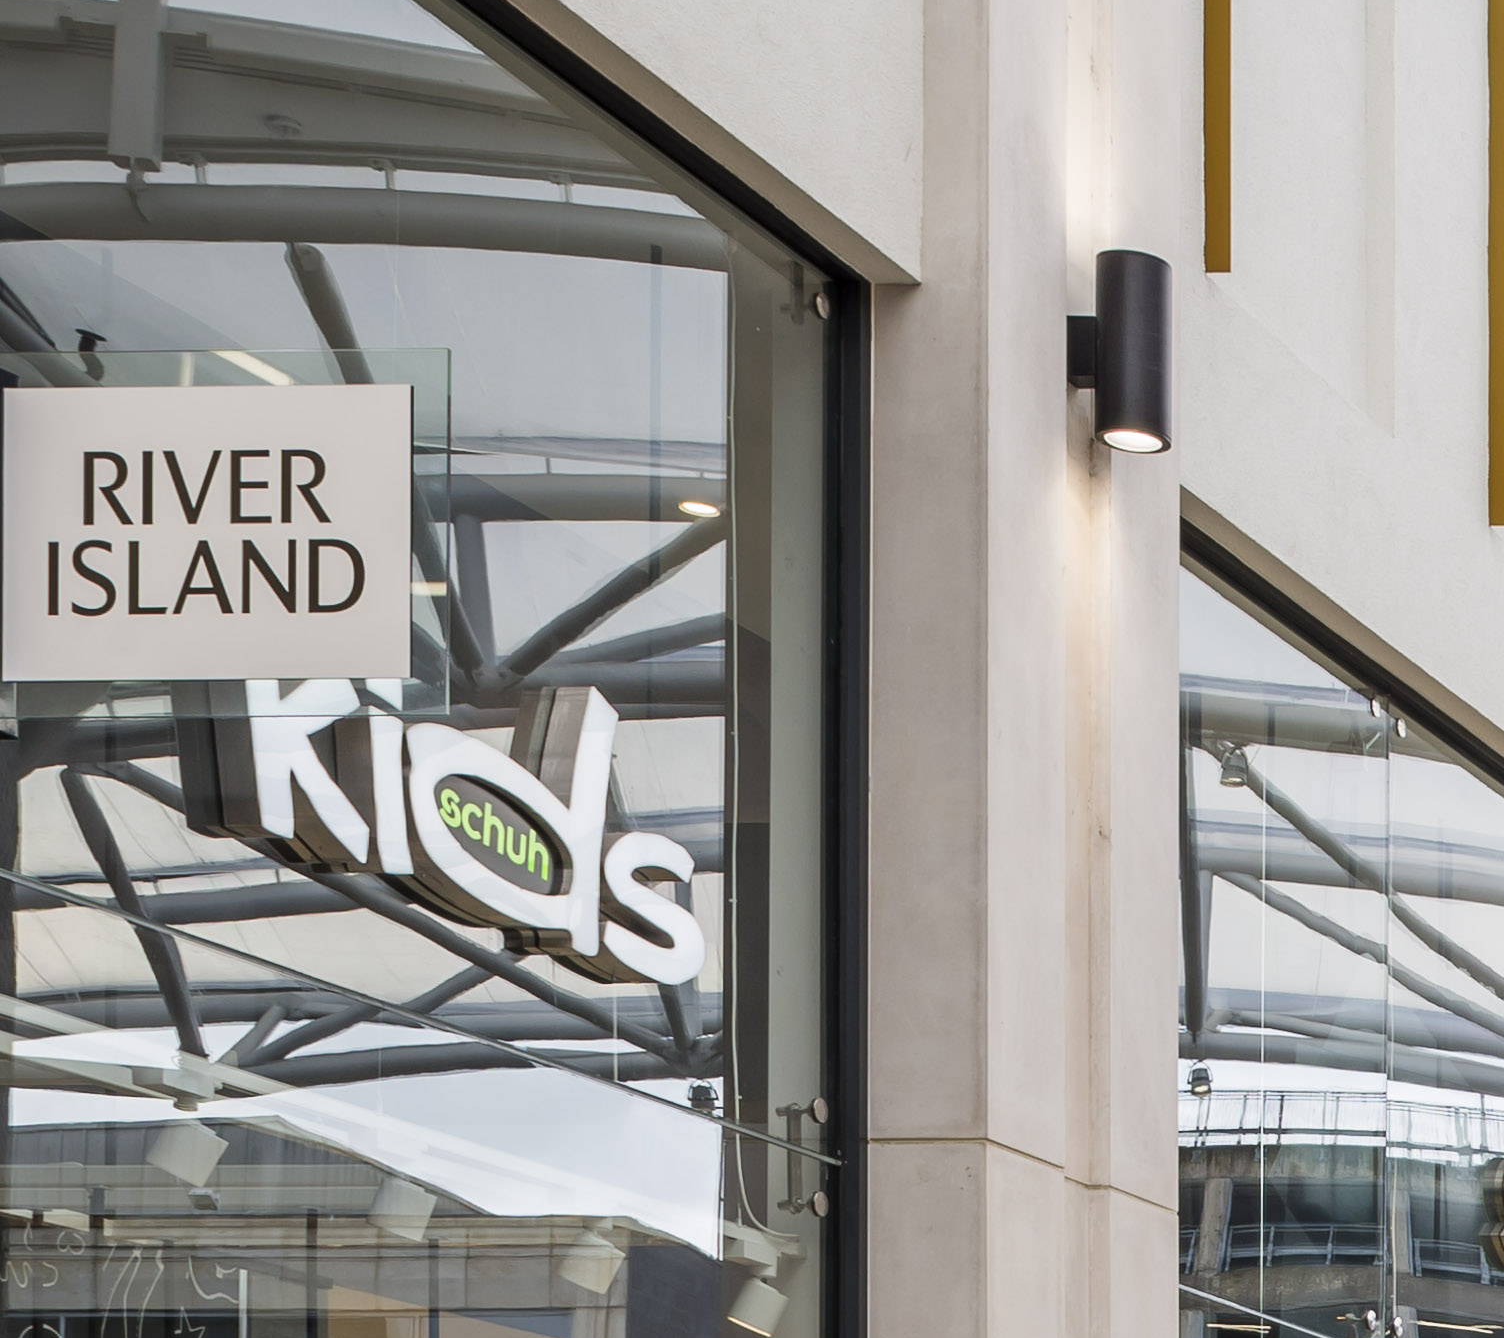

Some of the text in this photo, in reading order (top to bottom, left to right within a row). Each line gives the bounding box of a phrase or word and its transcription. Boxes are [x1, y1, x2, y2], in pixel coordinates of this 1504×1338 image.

[83, 449, 332, 526] RIVER
[47, 539, 366, 615] ISLAND
[439, 788, 550, 881] schuh
